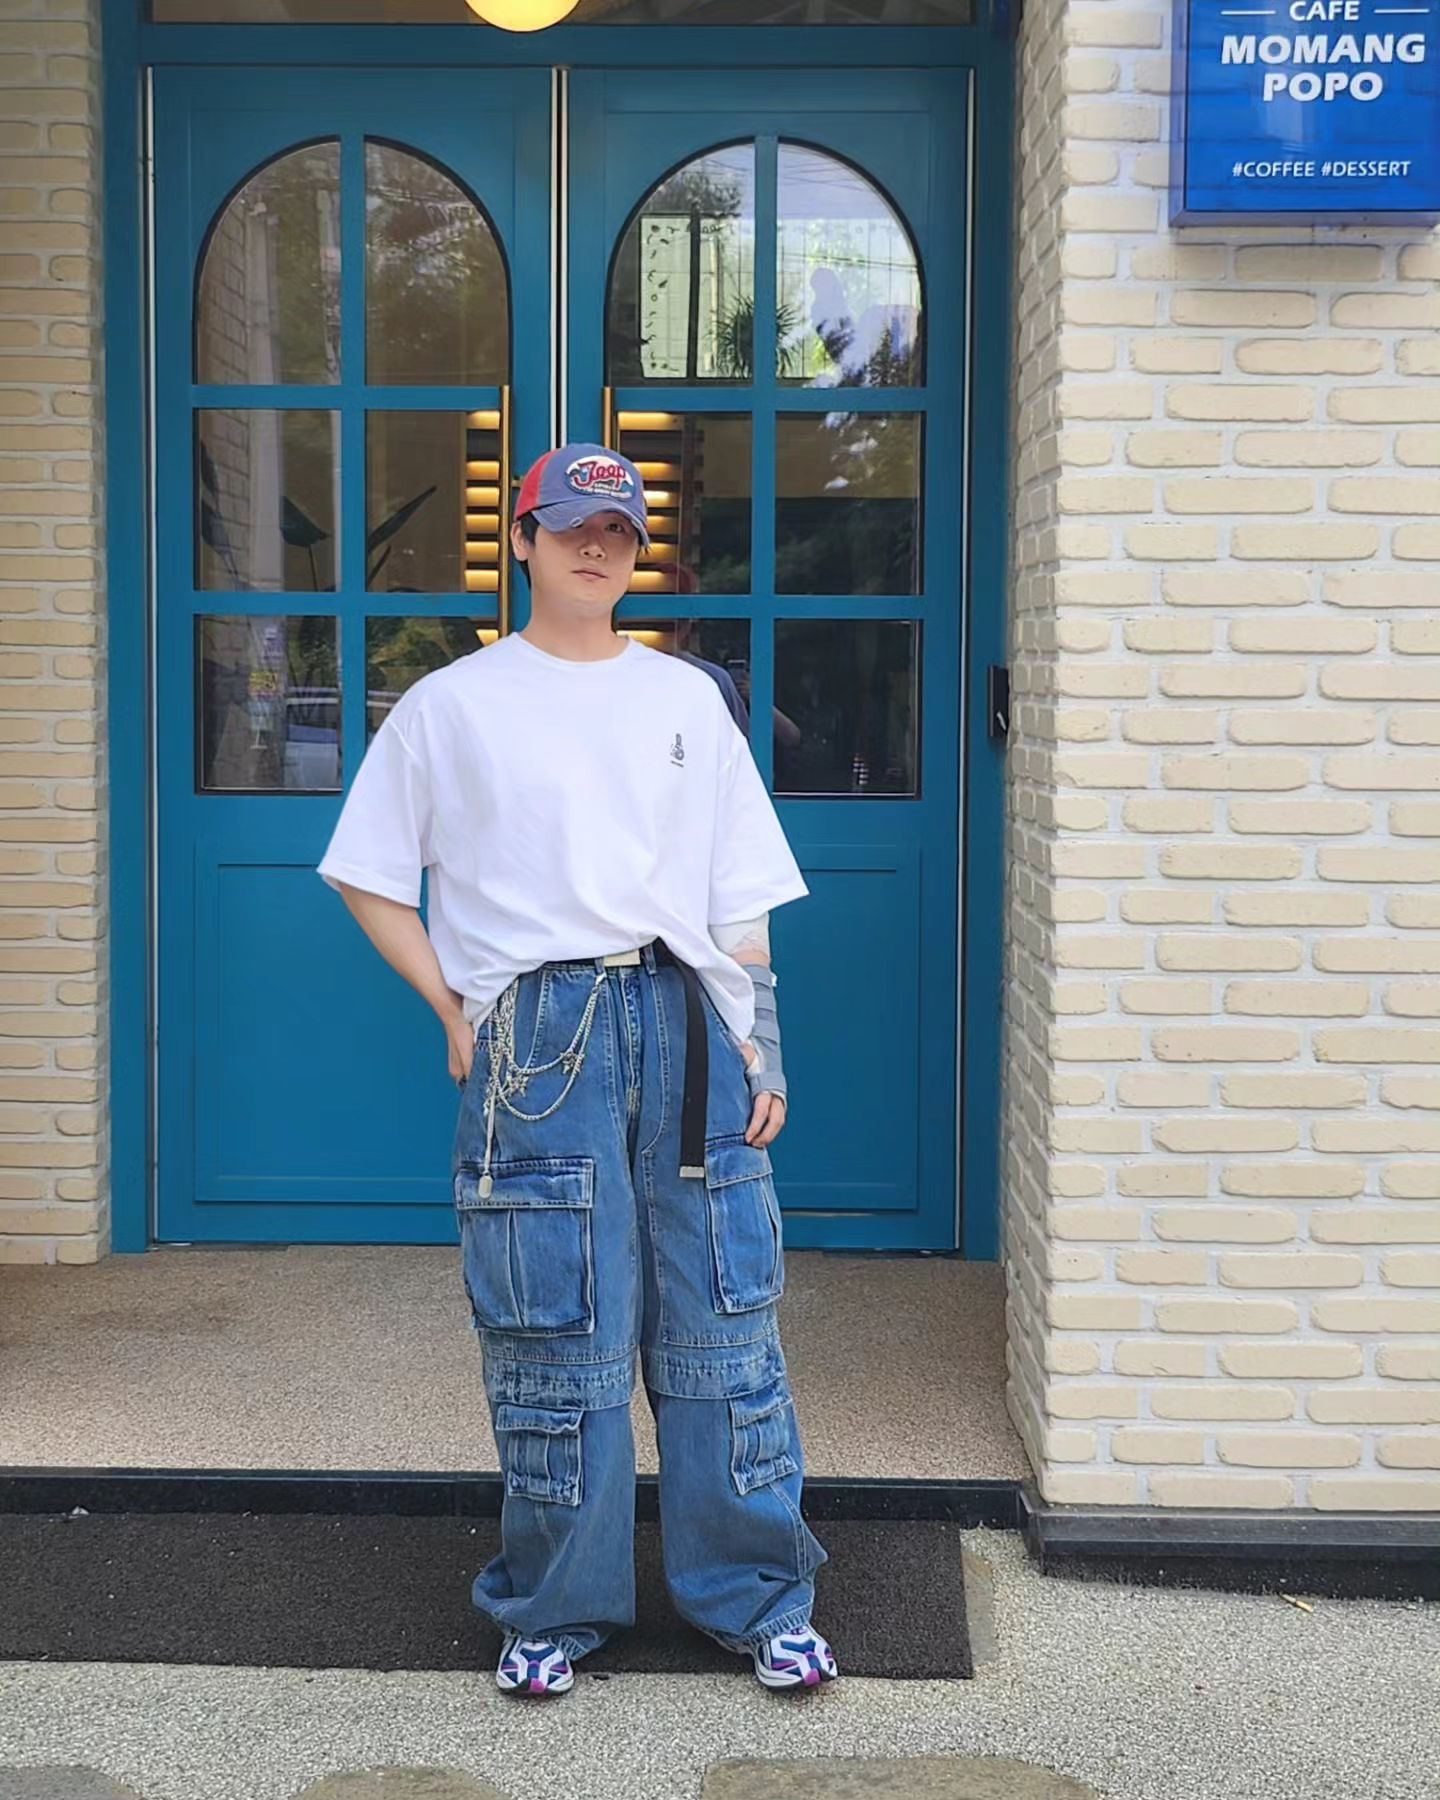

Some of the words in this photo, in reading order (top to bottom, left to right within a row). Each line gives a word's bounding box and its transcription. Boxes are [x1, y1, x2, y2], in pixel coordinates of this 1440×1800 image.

[1289, 1, 1360, 21] CAFE
[1221, 33, 1425, 64] MOMANG
[1263, 72, 1384, 101] POPO
[1232, 161, 1315, 177] #COFFEE
[1321, 161, 1411, 176] #DESSERT
[573, 460, 626, 488] Jeep
